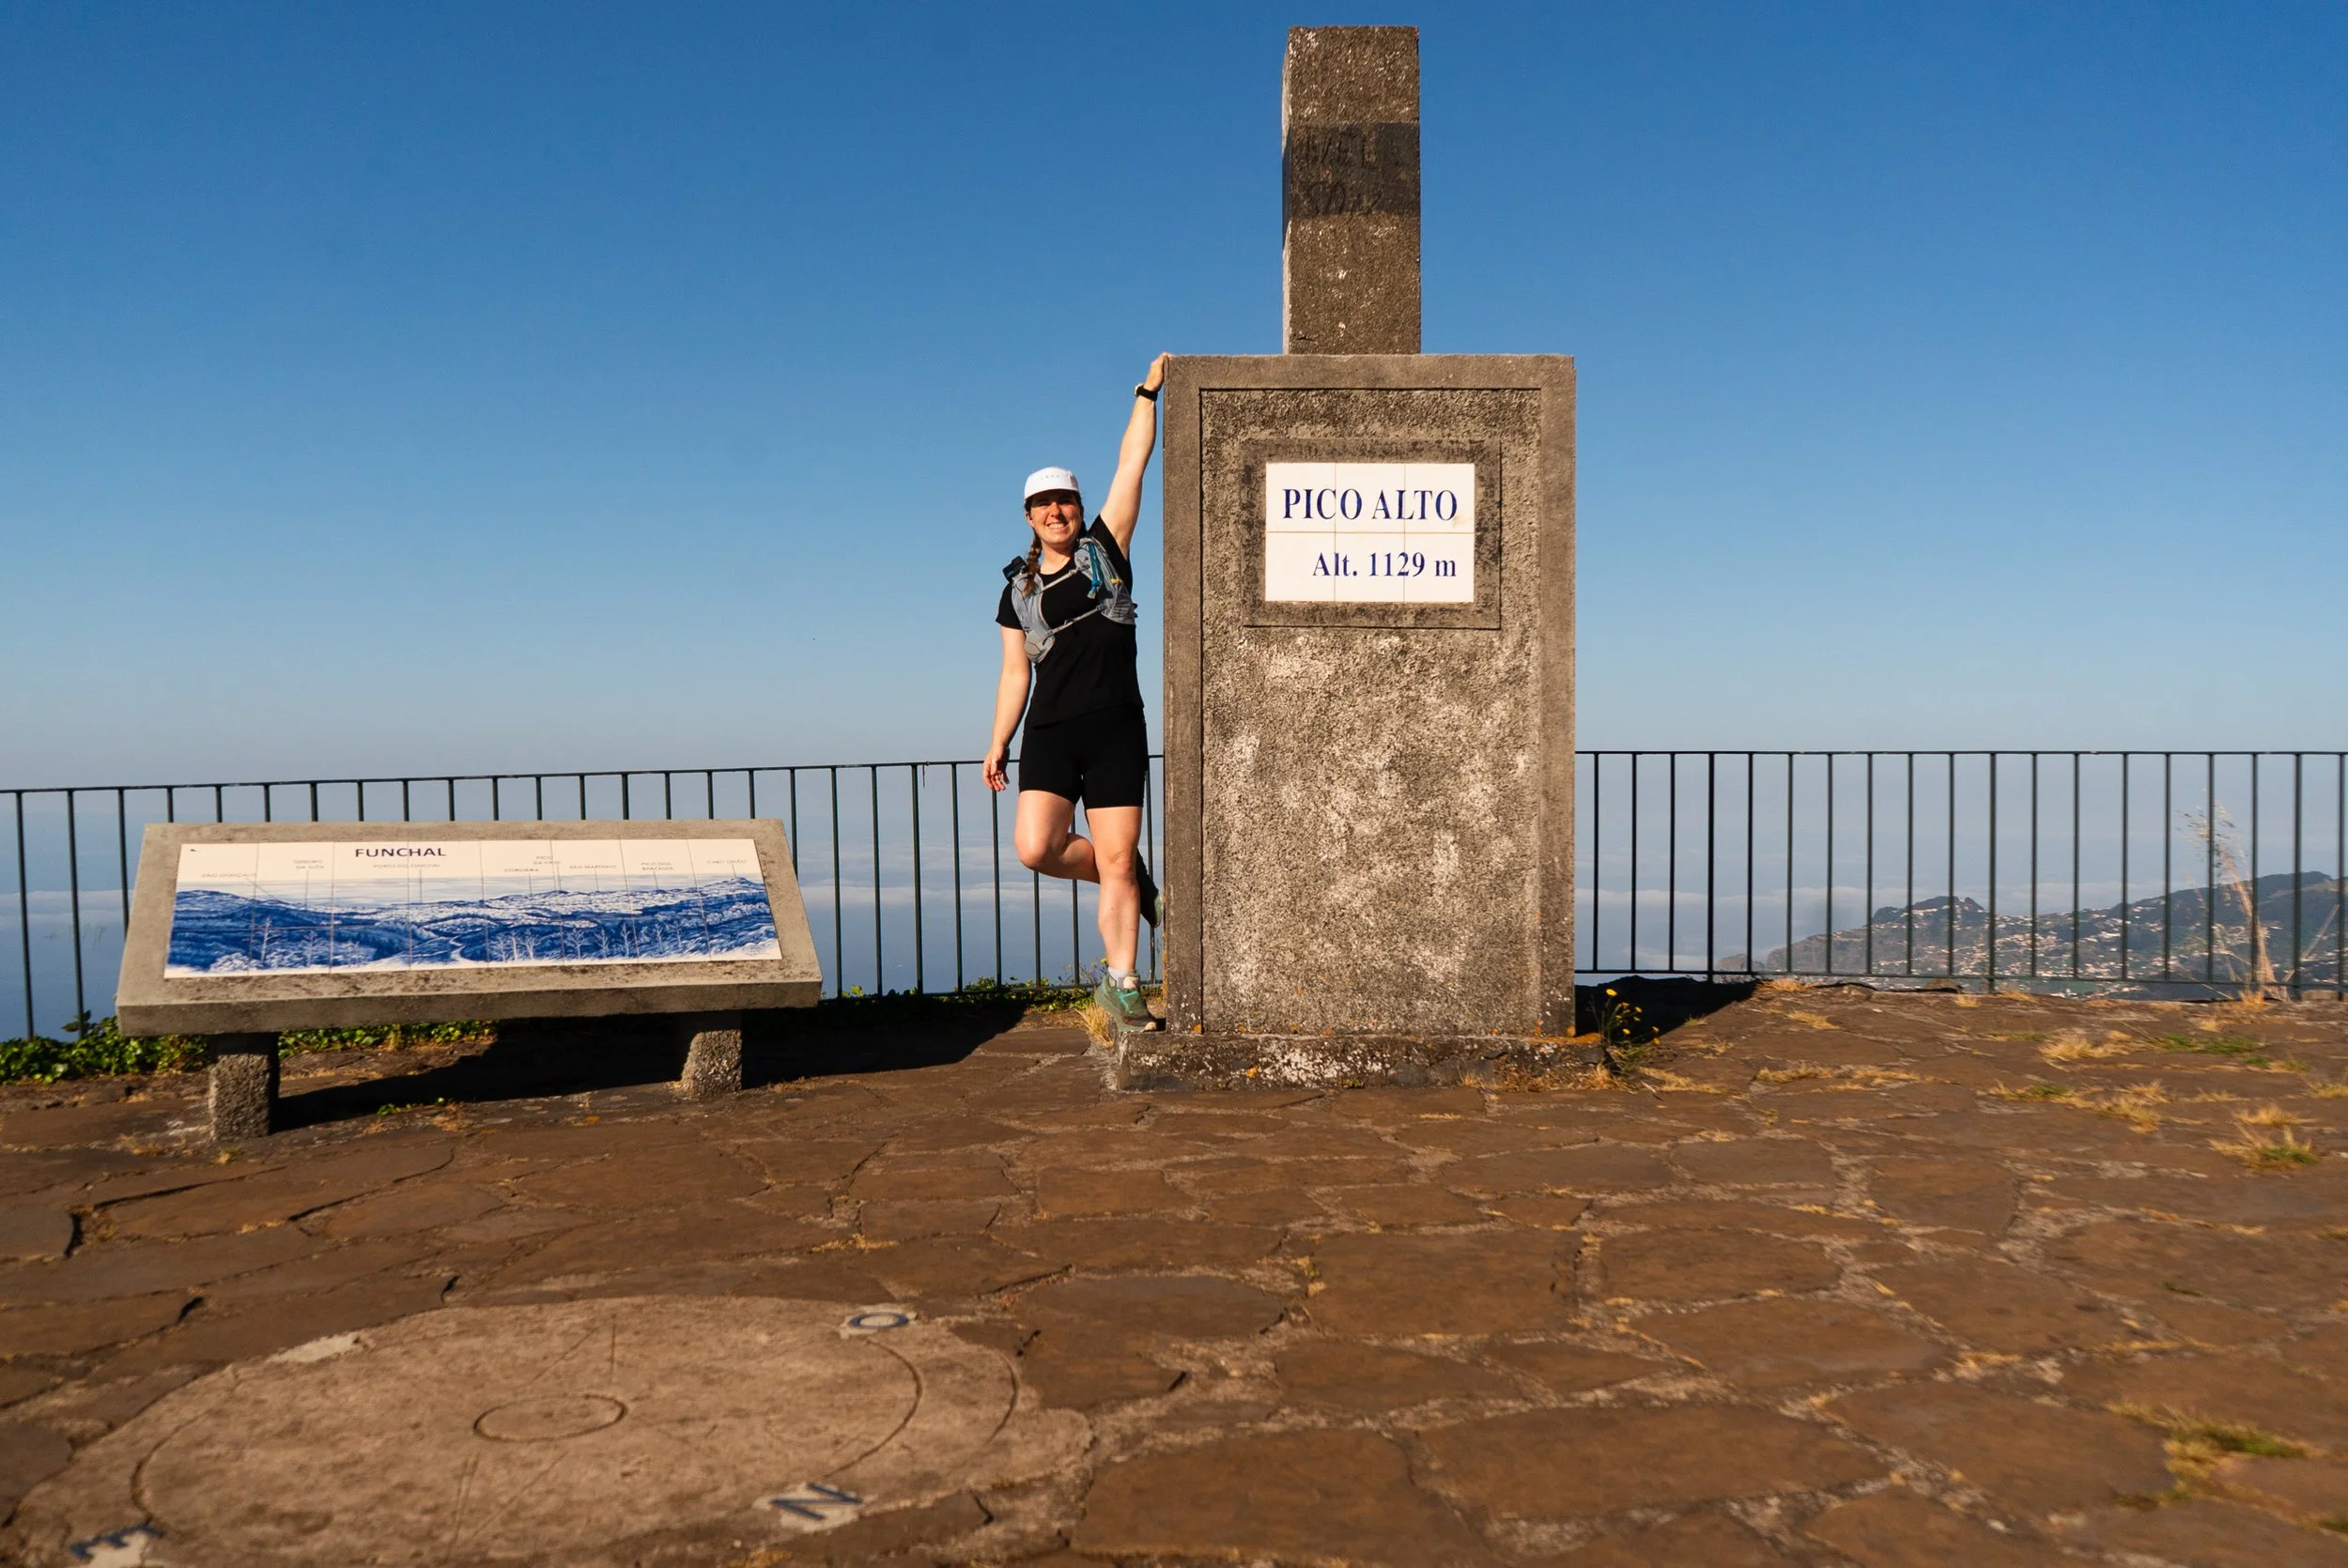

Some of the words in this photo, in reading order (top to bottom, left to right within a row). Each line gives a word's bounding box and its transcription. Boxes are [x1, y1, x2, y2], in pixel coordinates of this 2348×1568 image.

[1283, 488, 1363, 520] PICO
[1371, 489, 1458, 521] ALTO
[1312, 552, 1358, 576] Alt.
[1368, 551, 1426, 577] 1129
[1435, 560, 1457, 577] m
[355, 847, 447, 858] FUNCHAL
